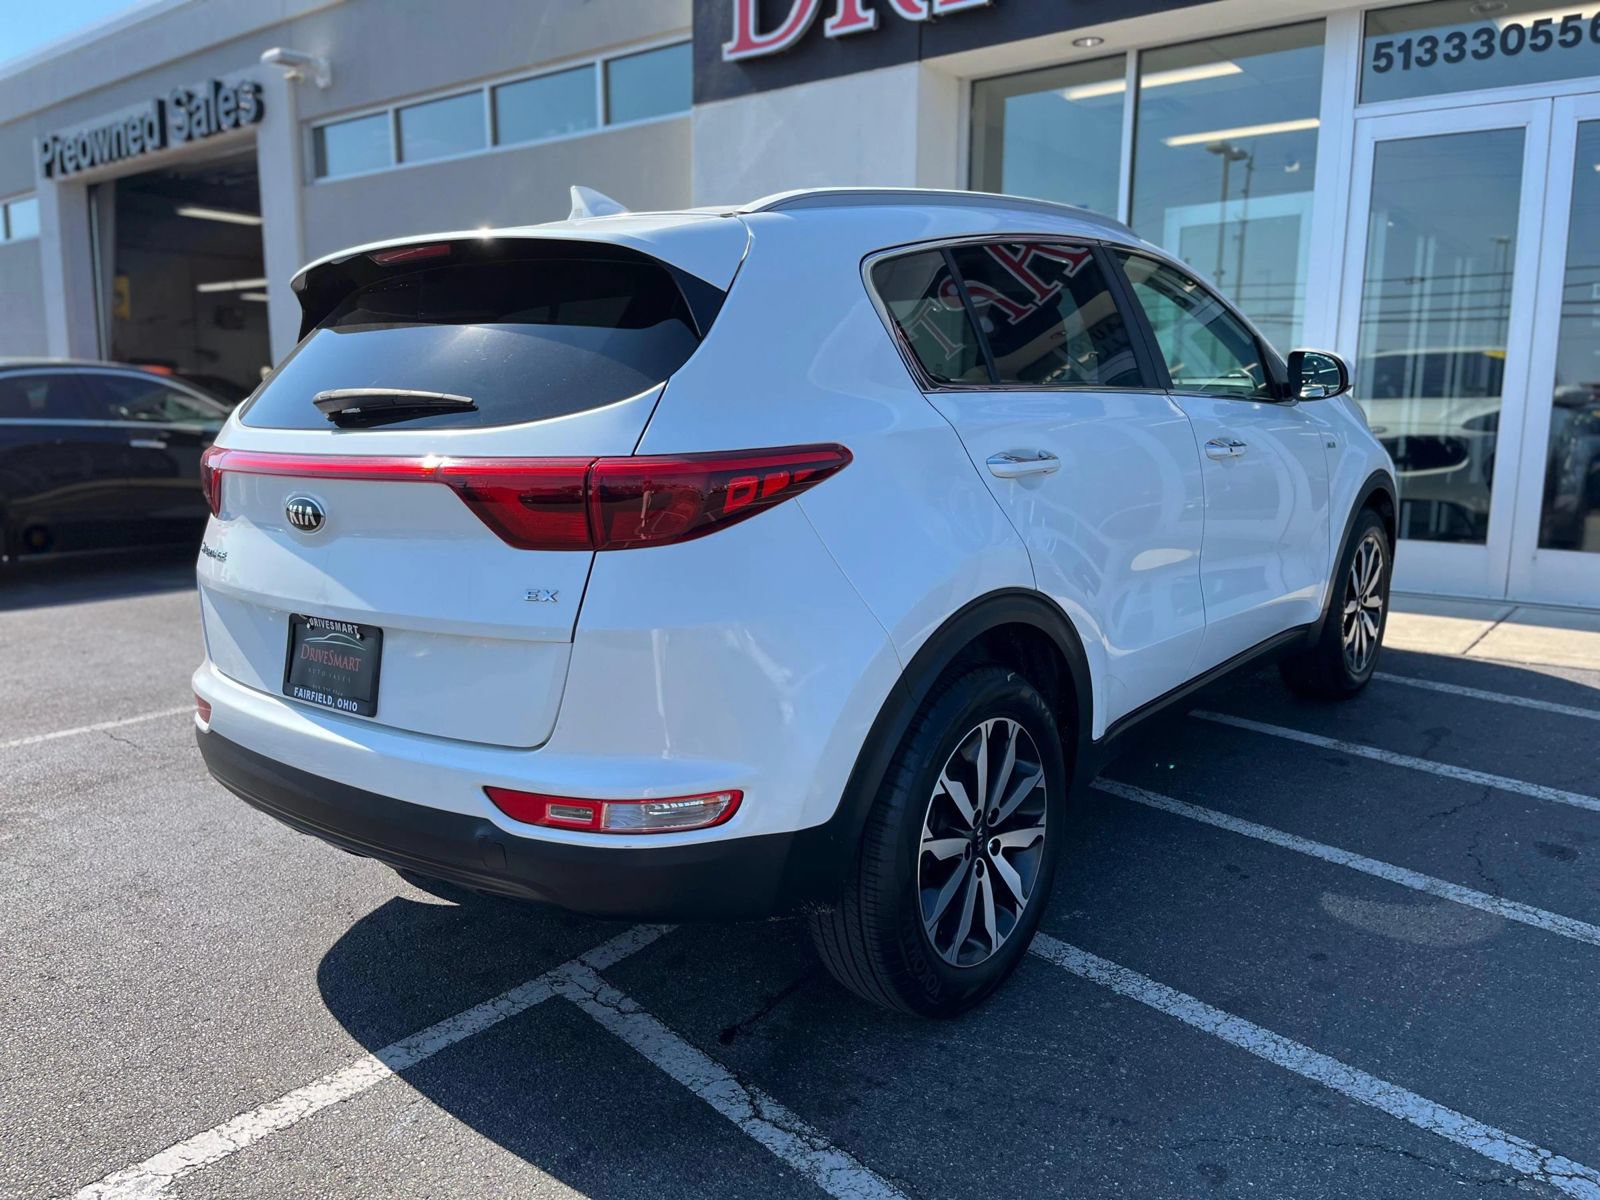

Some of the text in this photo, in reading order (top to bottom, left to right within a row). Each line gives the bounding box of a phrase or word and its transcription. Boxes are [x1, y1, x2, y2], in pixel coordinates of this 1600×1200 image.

[42, 78, 264, 178] Preowned Sales
[289, 504, 317, 526] KIA
[524, 589, 559, 602] EX
[308, 617, 359, 635] DRIVESMART
[293, 687, 335, 708] FAIRFIELD,
[337, 697, 358, 711] OHIO
